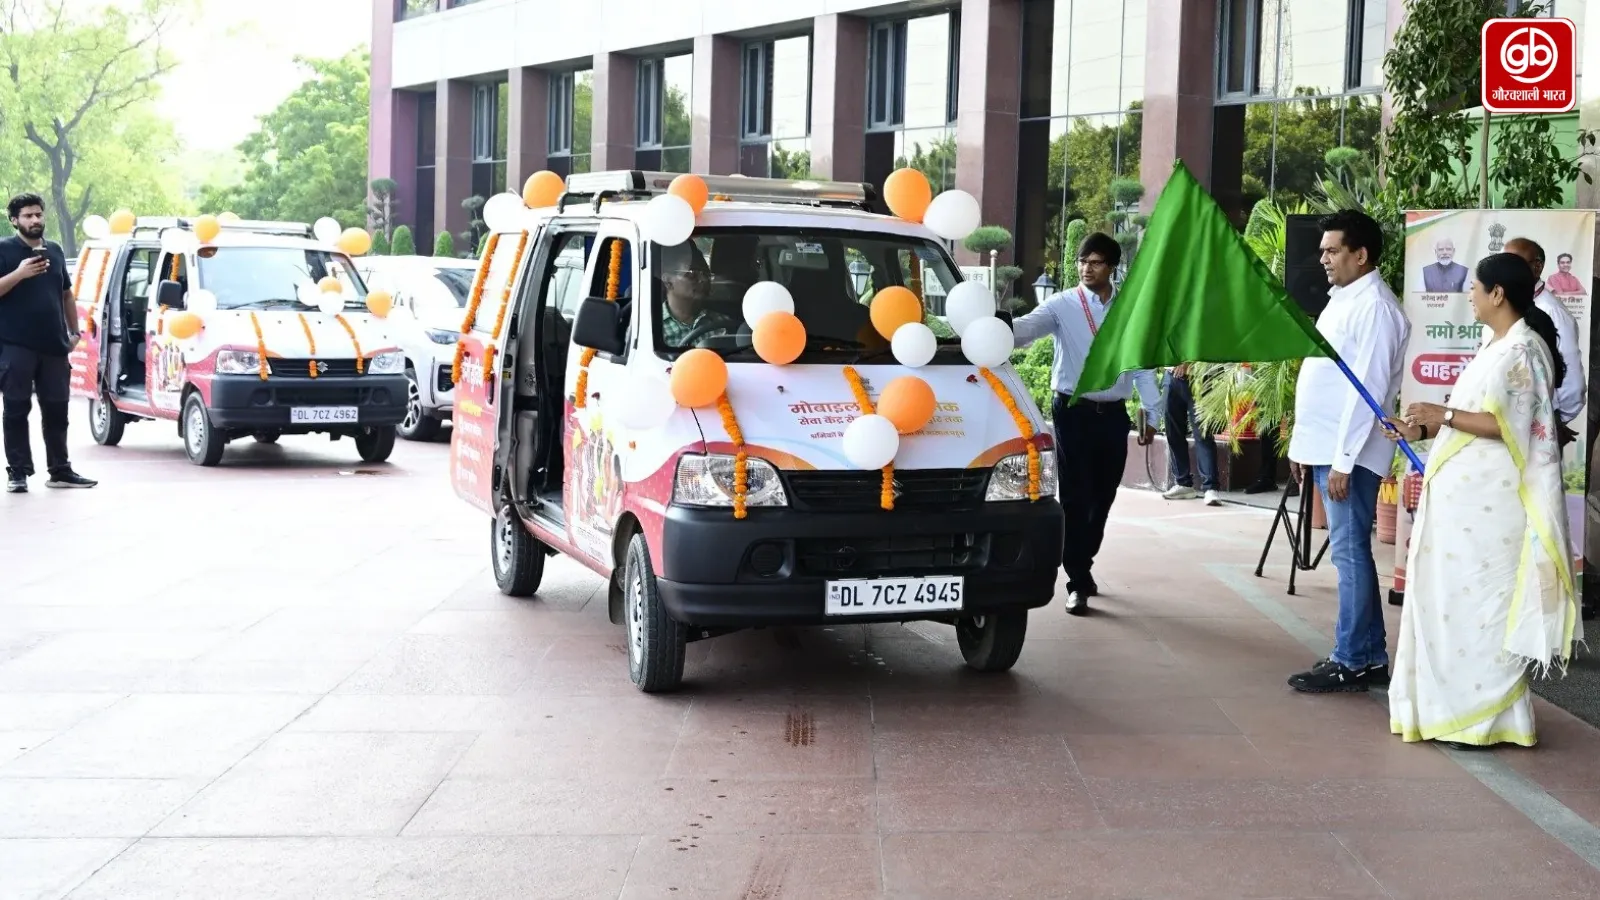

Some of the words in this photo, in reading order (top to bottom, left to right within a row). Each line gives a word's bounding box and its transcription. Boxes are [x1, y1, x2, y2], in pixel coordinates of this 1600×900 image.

[1425, 320, 1454, 339] नमो
[788, 400, 860, 414] मोबाइल
[297, 410, 309, 420] DL
[313, 410, 330, 420] 7CZ
[333, 409, 357, 419] 4962
[798, 416, 823, 426] सेवा
[841, 586, 864, 607] DL
[872, 584, 907, 606] 7CZ
[914, 582, 960, 604] 4945
